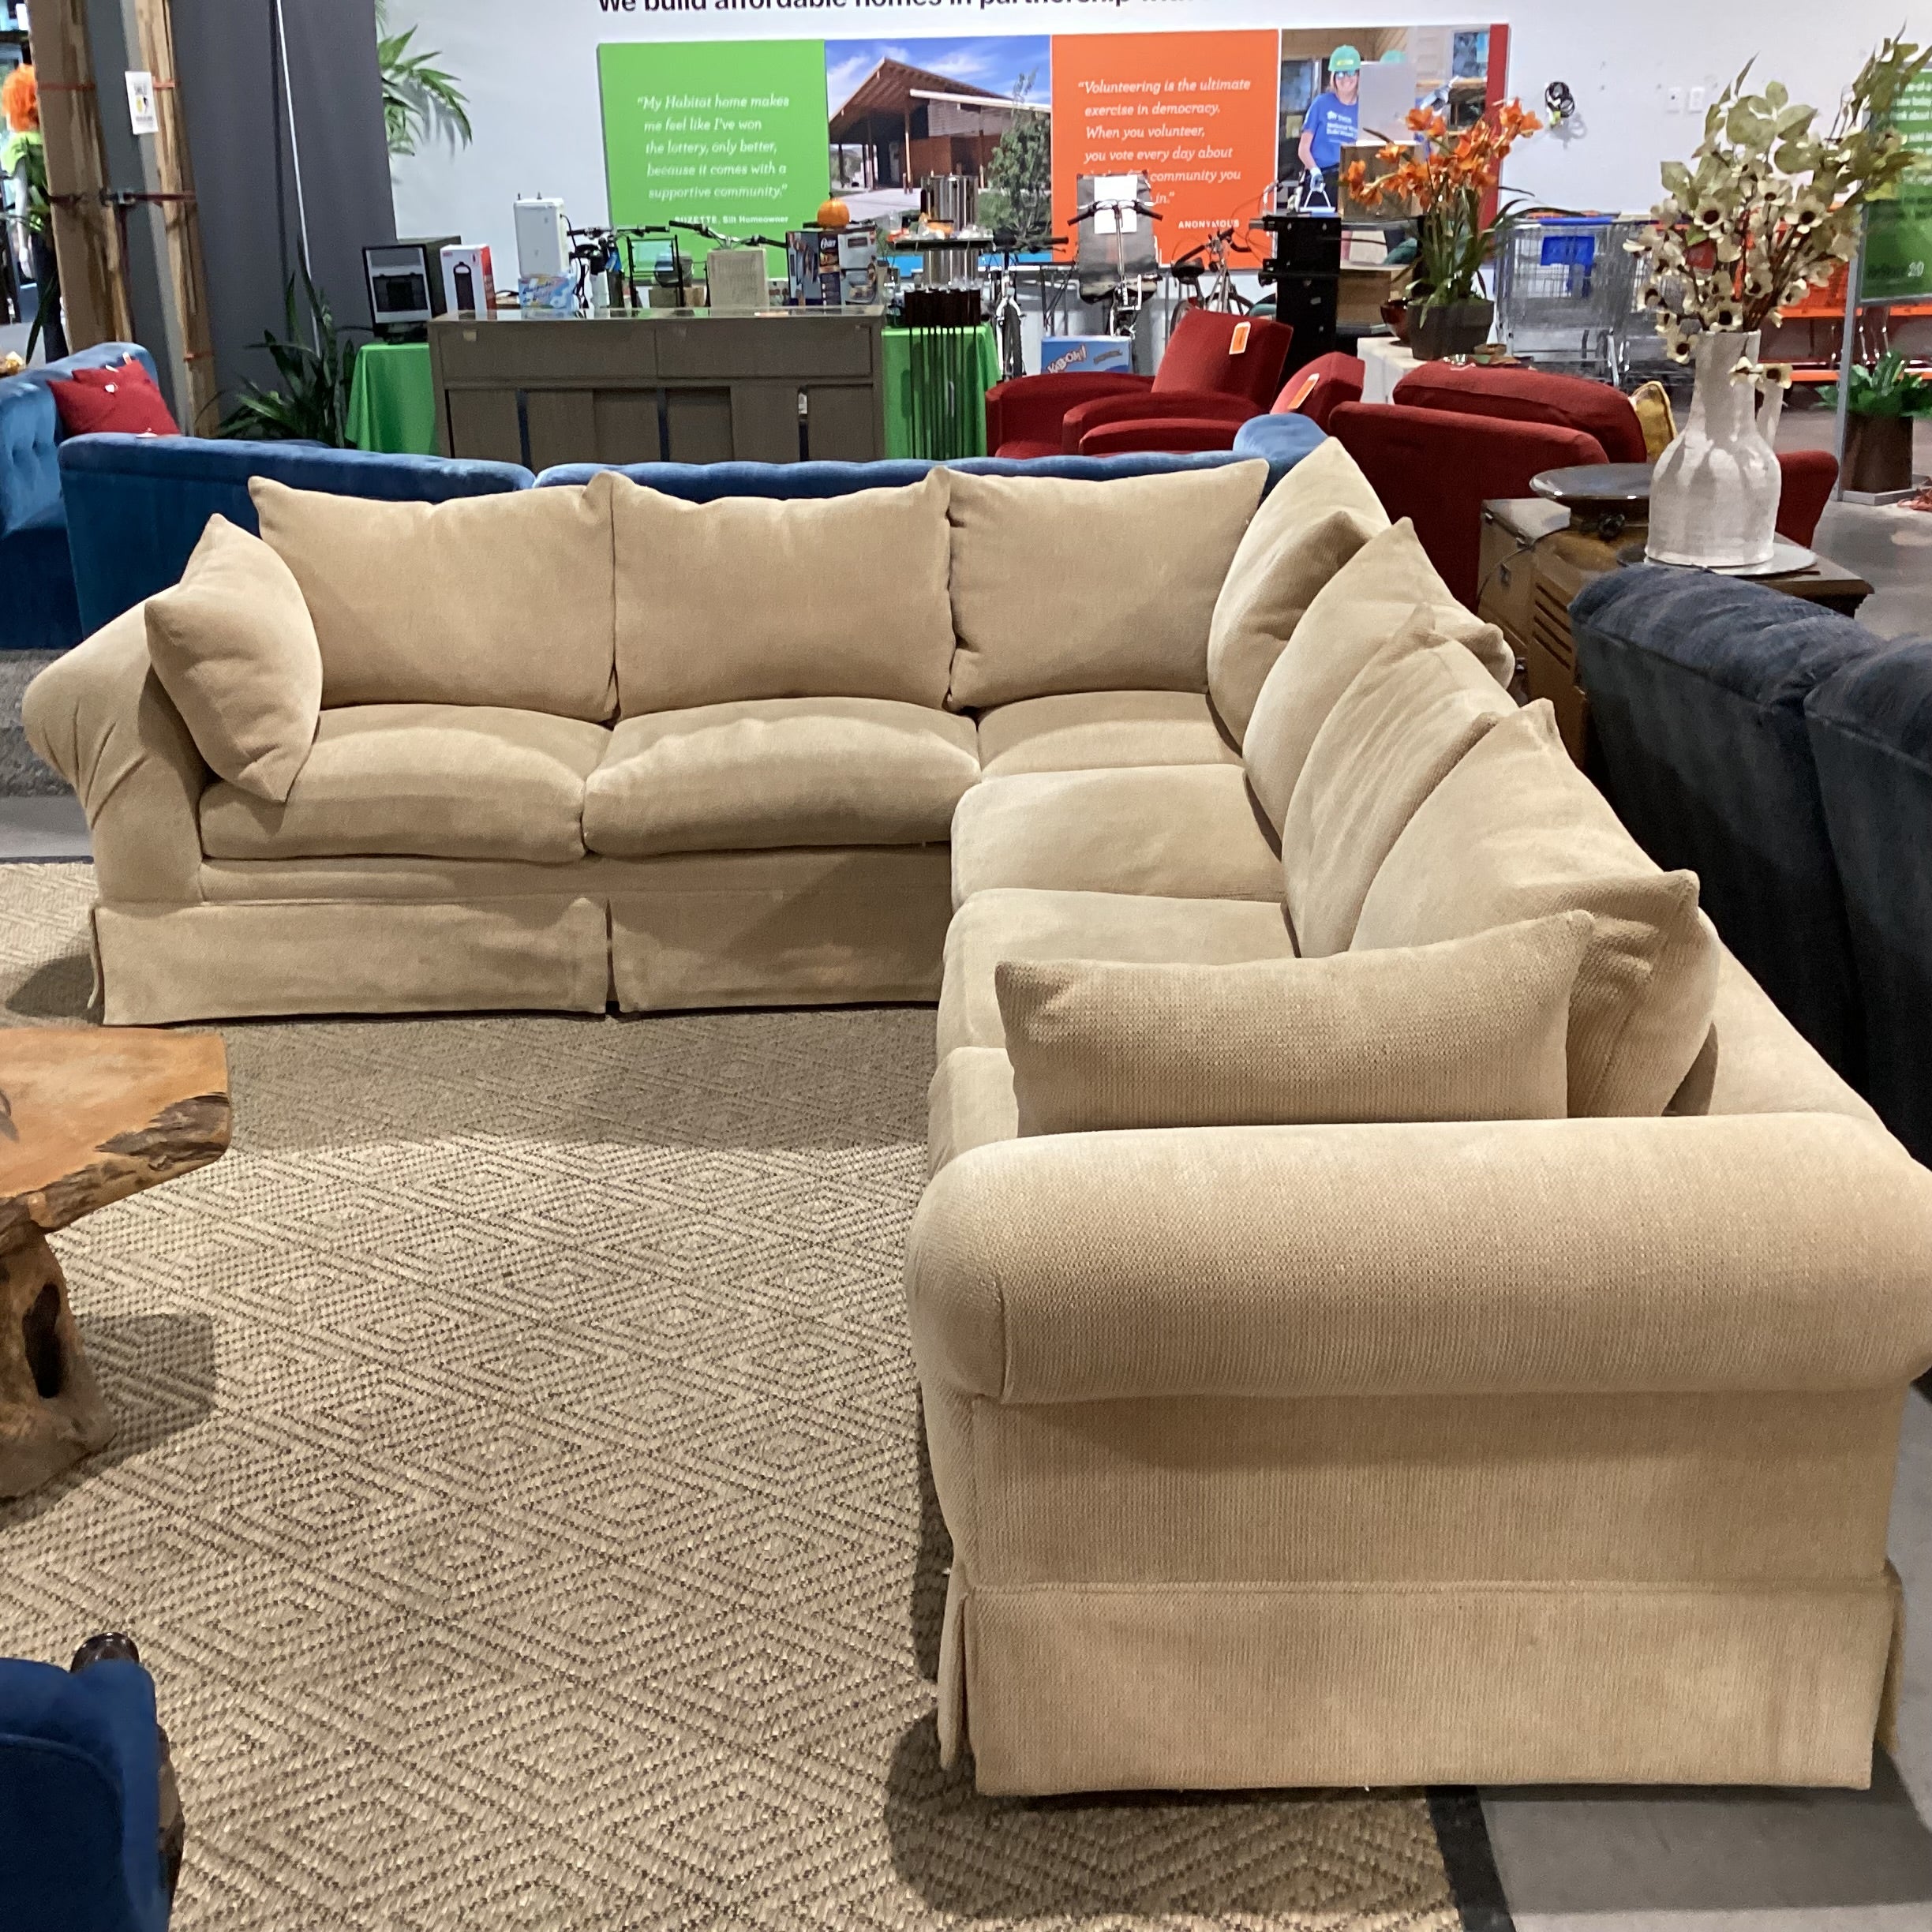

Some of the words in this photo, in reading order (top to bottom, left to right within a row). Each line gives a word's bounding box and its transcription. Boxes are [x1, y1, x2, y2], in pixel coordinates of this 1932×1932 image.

[1164, 80, 1174, 92] is
[1178, 77, 1196, 92] the
[1200, 77, 1251, 91] ultimate
[665, 95, 711, 110] Habitat
[715, 93, 747, 108] home
[751, 92, 789, 107] makes
[1084, 104, 1134, 117] exercise
[1137, 103, 1149, 115] in
[644, 121, 661, 132] me
[665, 118, 686, 131] feel
[690, 118, 710, 131] like
[739, 120, 762, 131] won
[1086, 125, 1119, 139] When
[1121, 128, 1144, 141] you
[1148, 123, 1205, 139] volunteer,
[646, 140, 664, 154] the
[668, 140, 709, 157] lottery,
[712, 139, 737, 155] only
[740, 139, 777, 154] better,
[1084, 152, 1106, 164] you
[1110, 149, 1134, 161] vote
[1137, 149, 1170, 163] every
[1173, 145, 1195, 161] day
[1198, 144, 1233, 159] about
[647, 163, 695, 177] because
[699, 163, 707, 176] it
[710, 165, 747, 176] comes
[751, 160, 775, 174] with
[779, 164, 787, 174] a
[1150, 169, 1218, 183] community
[1218, 170, 1241, 184] you
[649, 186, 710, 200] supportive
[739, 215, 788, 224] Homeowner
[1178, 219, 1240, 229] ANONYMOUS
